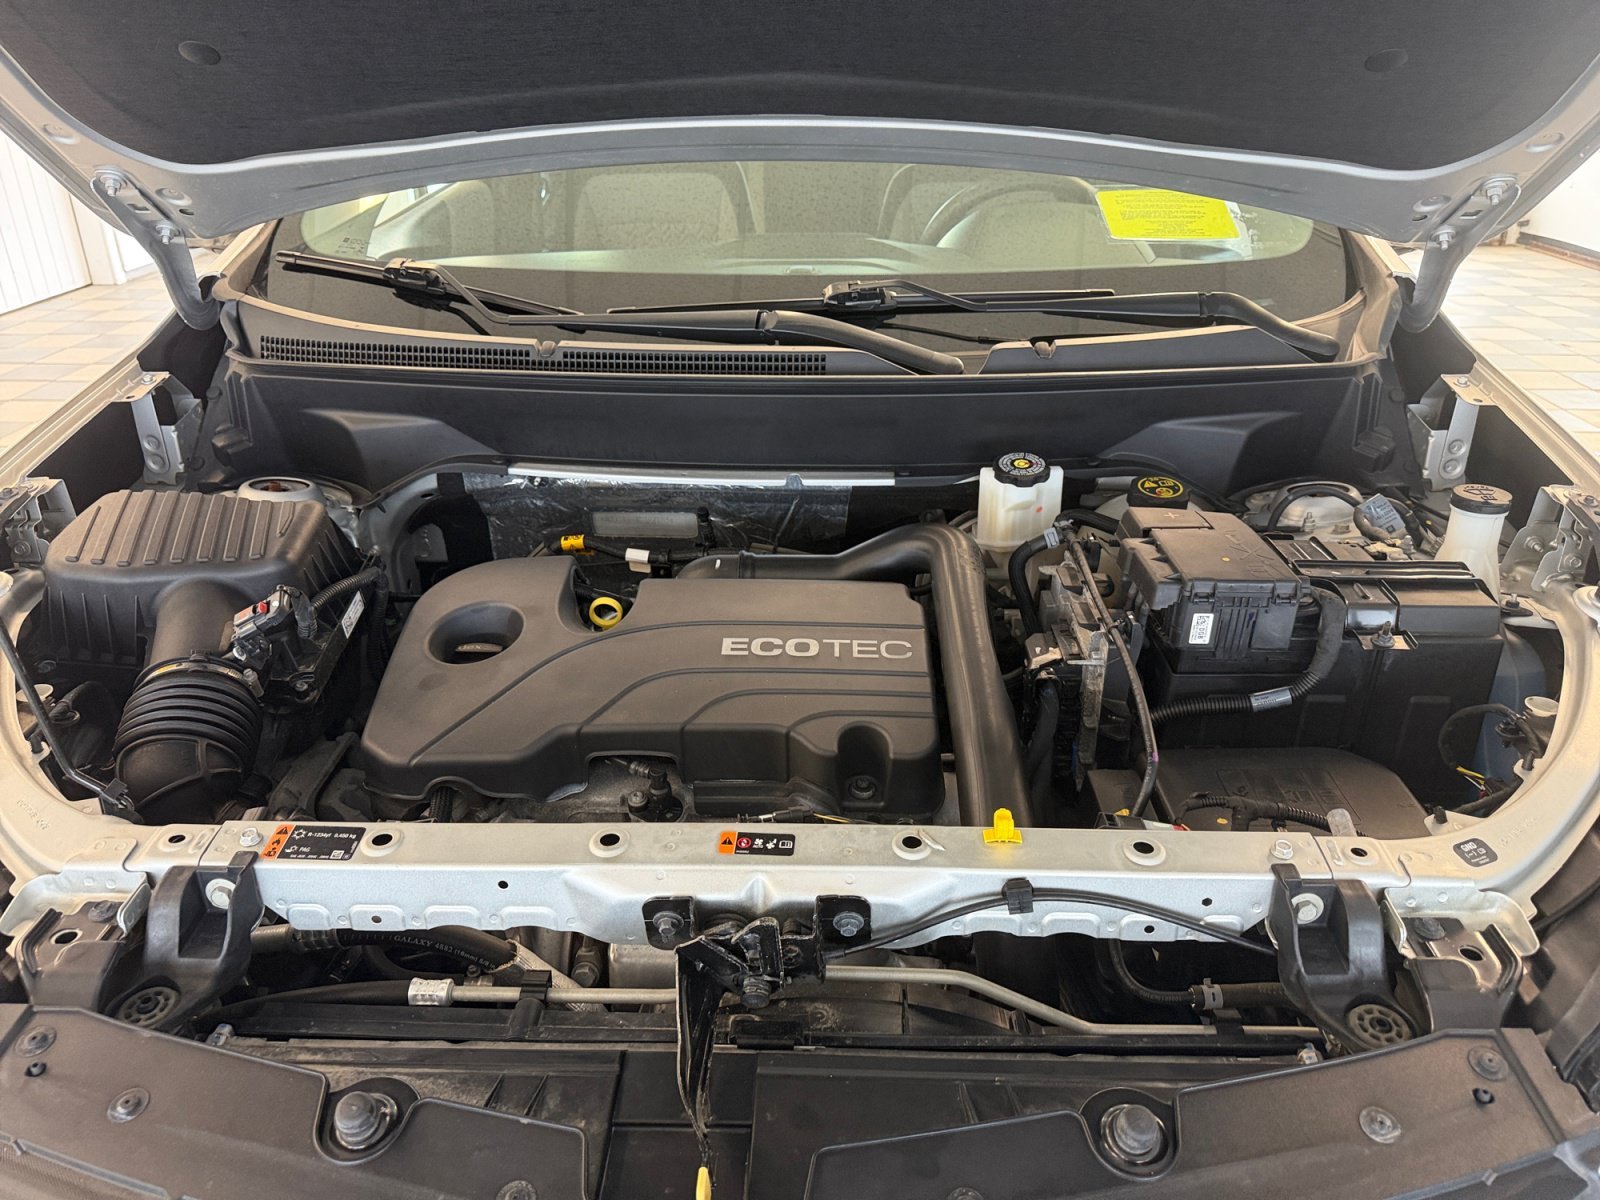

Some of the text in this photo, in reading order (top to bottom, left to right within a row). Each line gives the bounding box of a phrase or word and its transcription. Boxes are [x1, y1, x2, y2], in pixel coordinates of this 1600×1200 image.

[721, 637, 913, 659] ECOTEC
[349, 832, 357, 840] kg
[1460, 841, 1477, 851] GND
[394, 935, 433, 947] GALAXY
